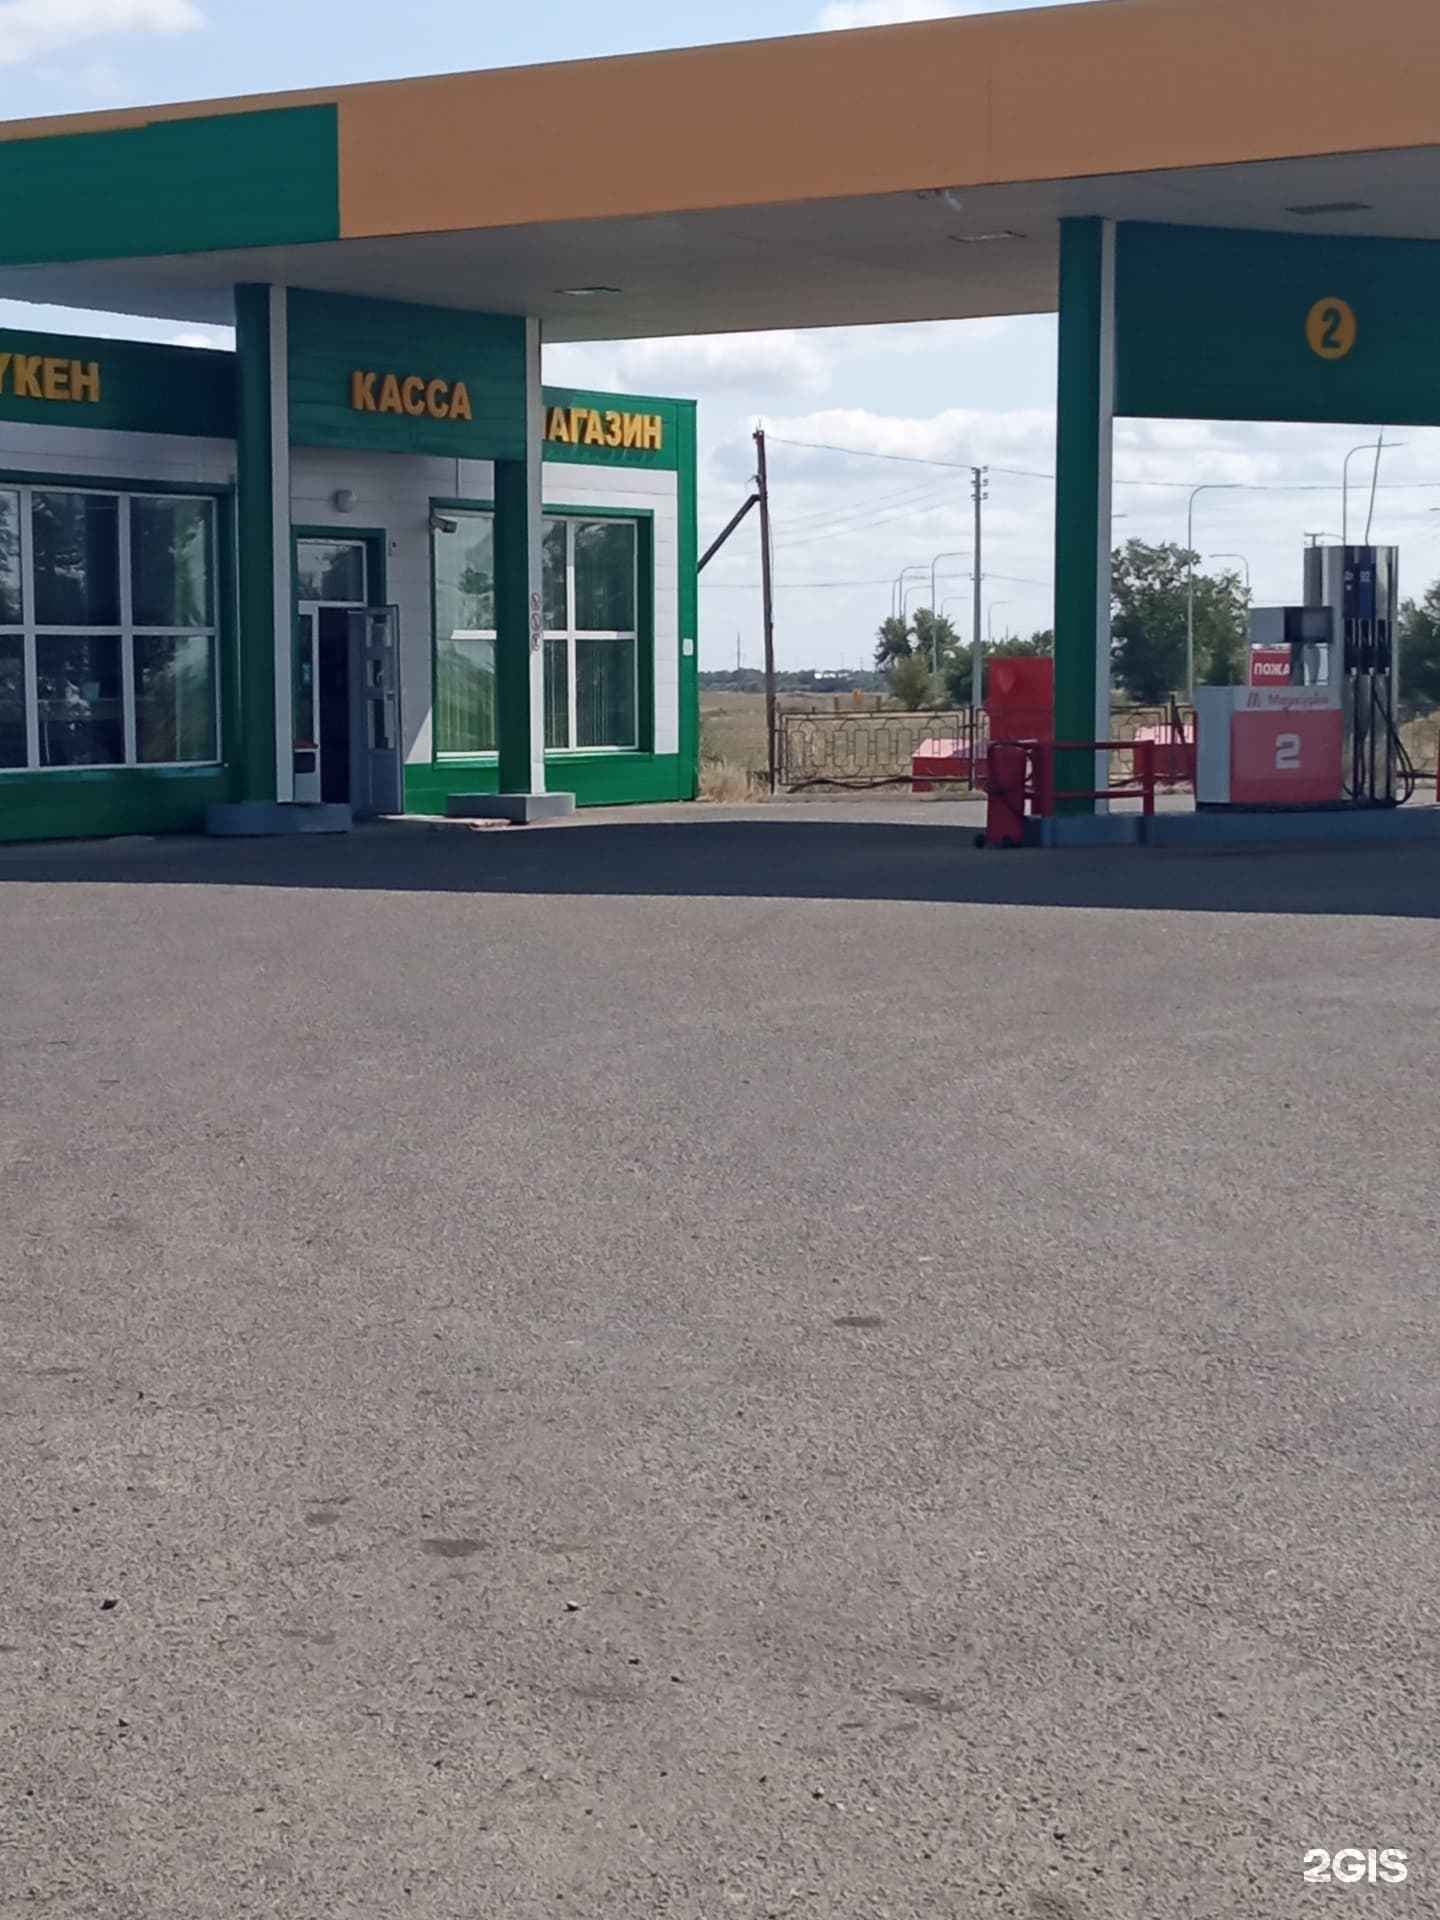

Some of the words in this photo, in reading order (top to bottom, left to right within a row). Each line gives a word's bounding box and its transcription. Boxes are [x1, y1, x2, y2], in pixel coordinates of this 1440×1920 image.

[1321, 307, 1342, 349] 2
[352, 370, 472, 420] КАССА
[543, 406, 662, 449] АГАЗИН
[1275, 733, 1301, 769] 2
